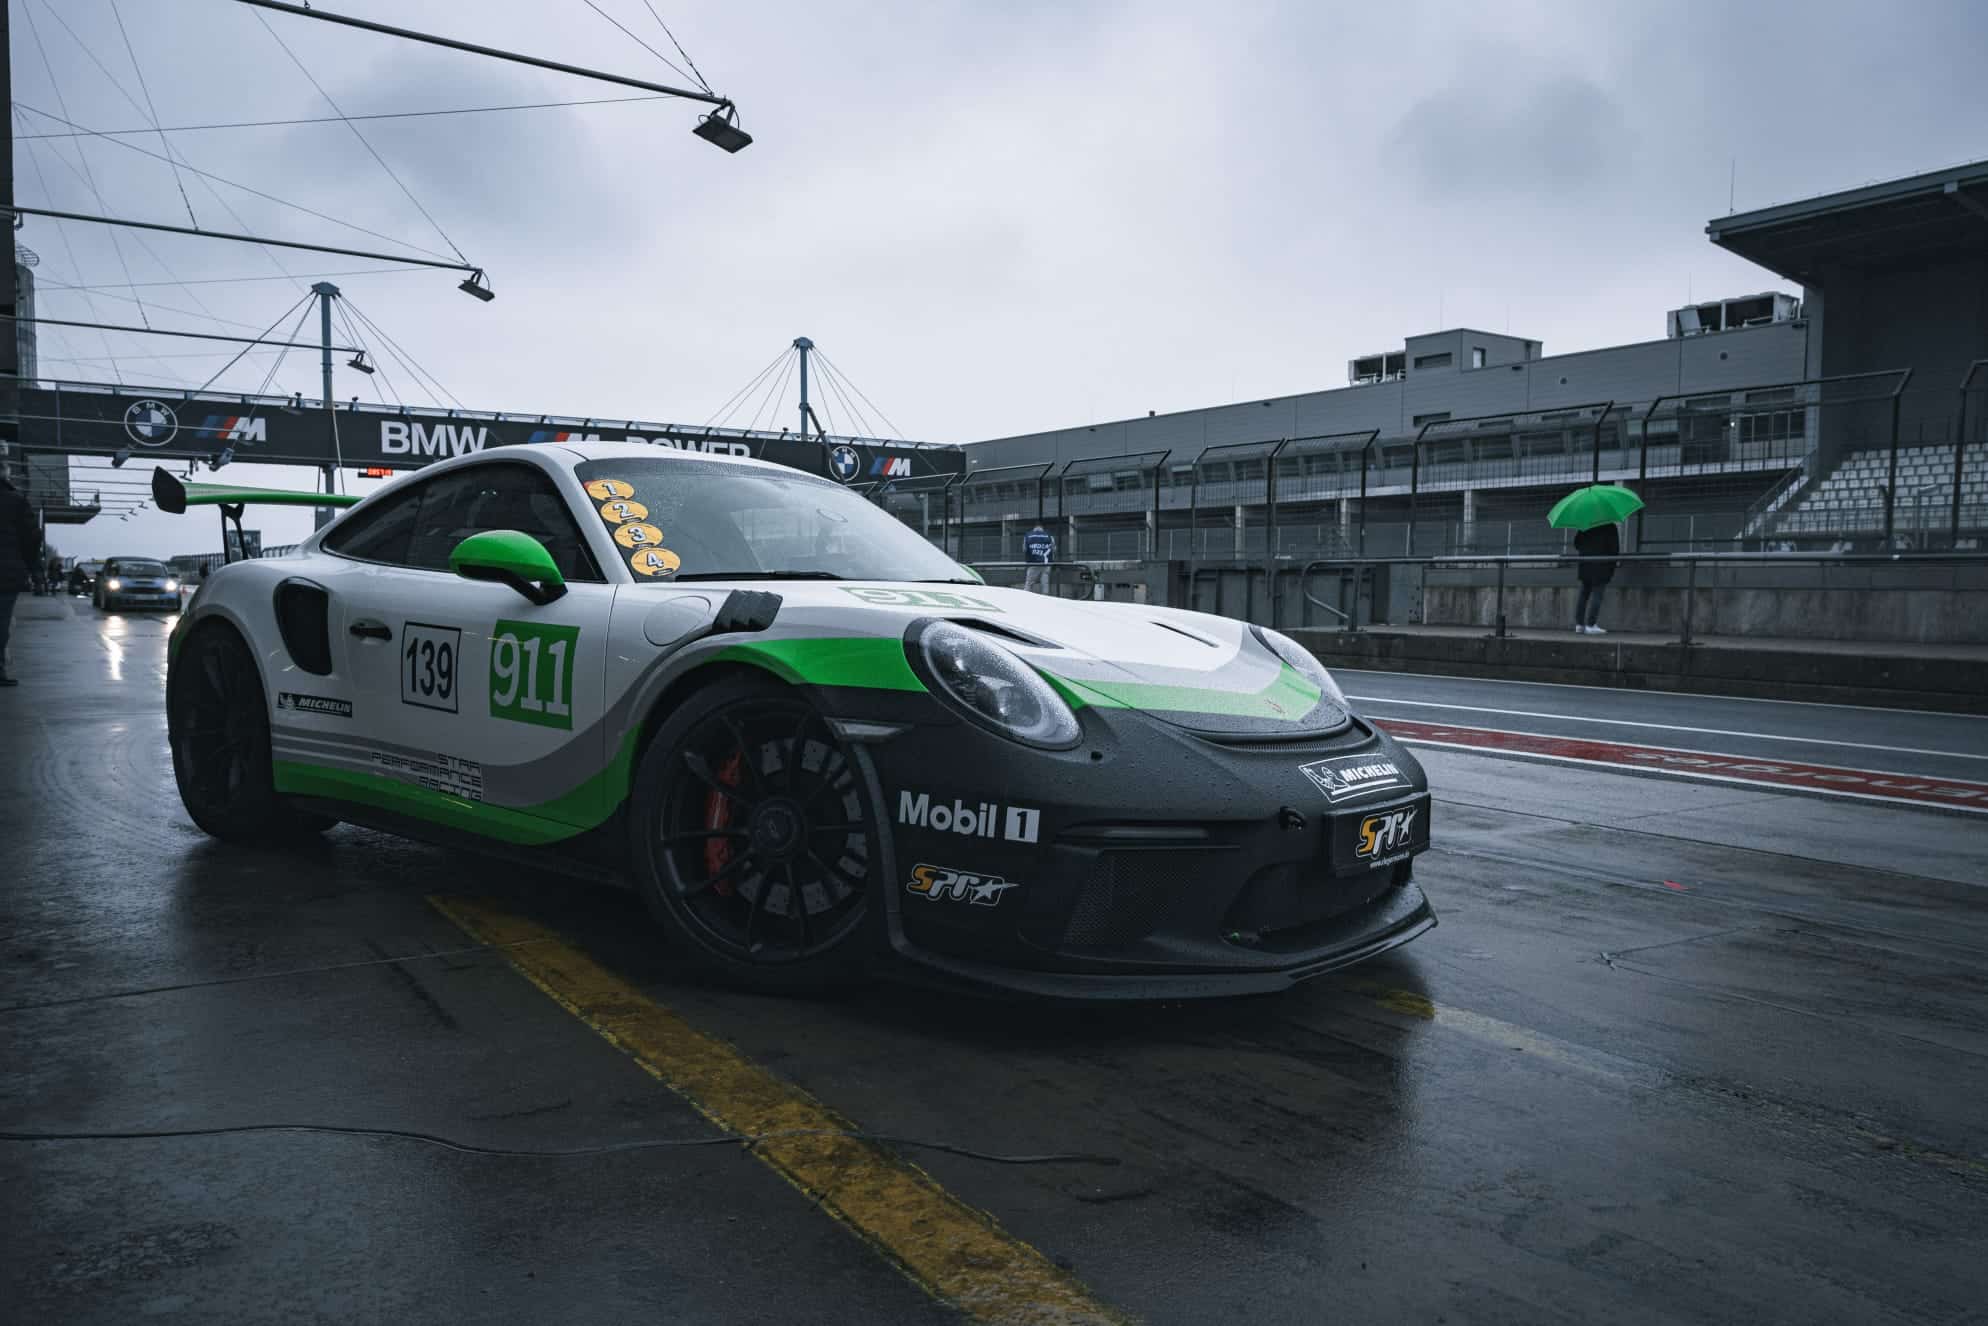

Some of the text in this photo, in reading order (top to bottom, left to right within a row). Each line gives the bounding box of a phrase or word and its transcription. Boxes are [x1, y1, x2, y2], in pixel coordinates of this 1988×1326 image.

[132, 402, 169, 416] BMW
[226, 416, 266, 441] M
[381, 420, 488, 457] BMW
[888, 458, 911, 476] M
[602, 482, 617, 496] 1
[613, 503, 634, 518] 2
[628, 526, 647, 542] 3
[647, 552, 664, 568] 4
[406, 637, 451, 699] 139
[492, 632, 569, 716] 911
[299, 696, 352, 713] MICHELIN
[438, 753, 481, 773] STAR
[1340, 763, 1399, 782] MICHELIN
[899, 790, 998, 838] Mobil
